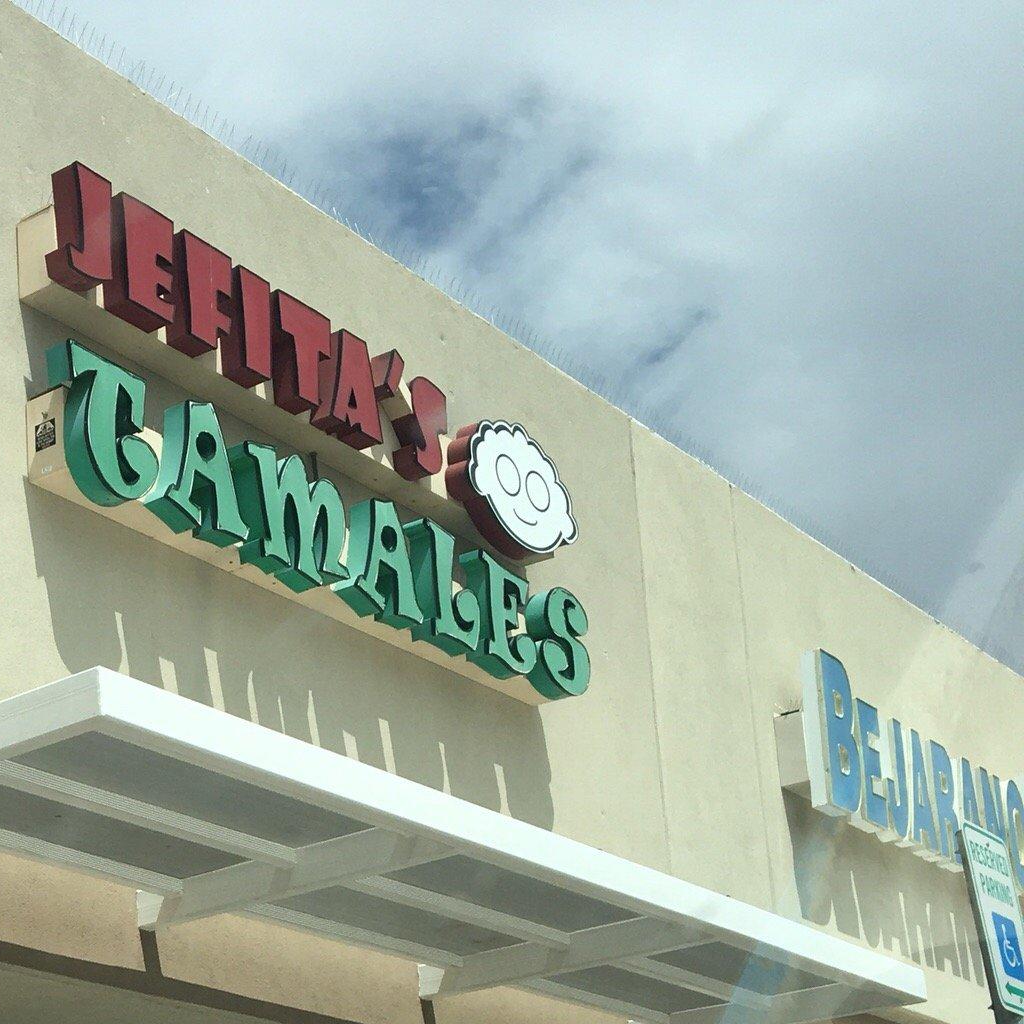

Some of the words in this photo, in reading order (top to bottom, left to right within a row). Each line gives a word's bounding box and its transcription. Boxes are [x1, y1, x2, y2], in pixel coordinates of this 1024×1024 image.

[46, 161, 448, 481] JEFITA'S
[62, 339, 591, 698] TAMALES
[969, 840, 1009, 877] RESERVED
